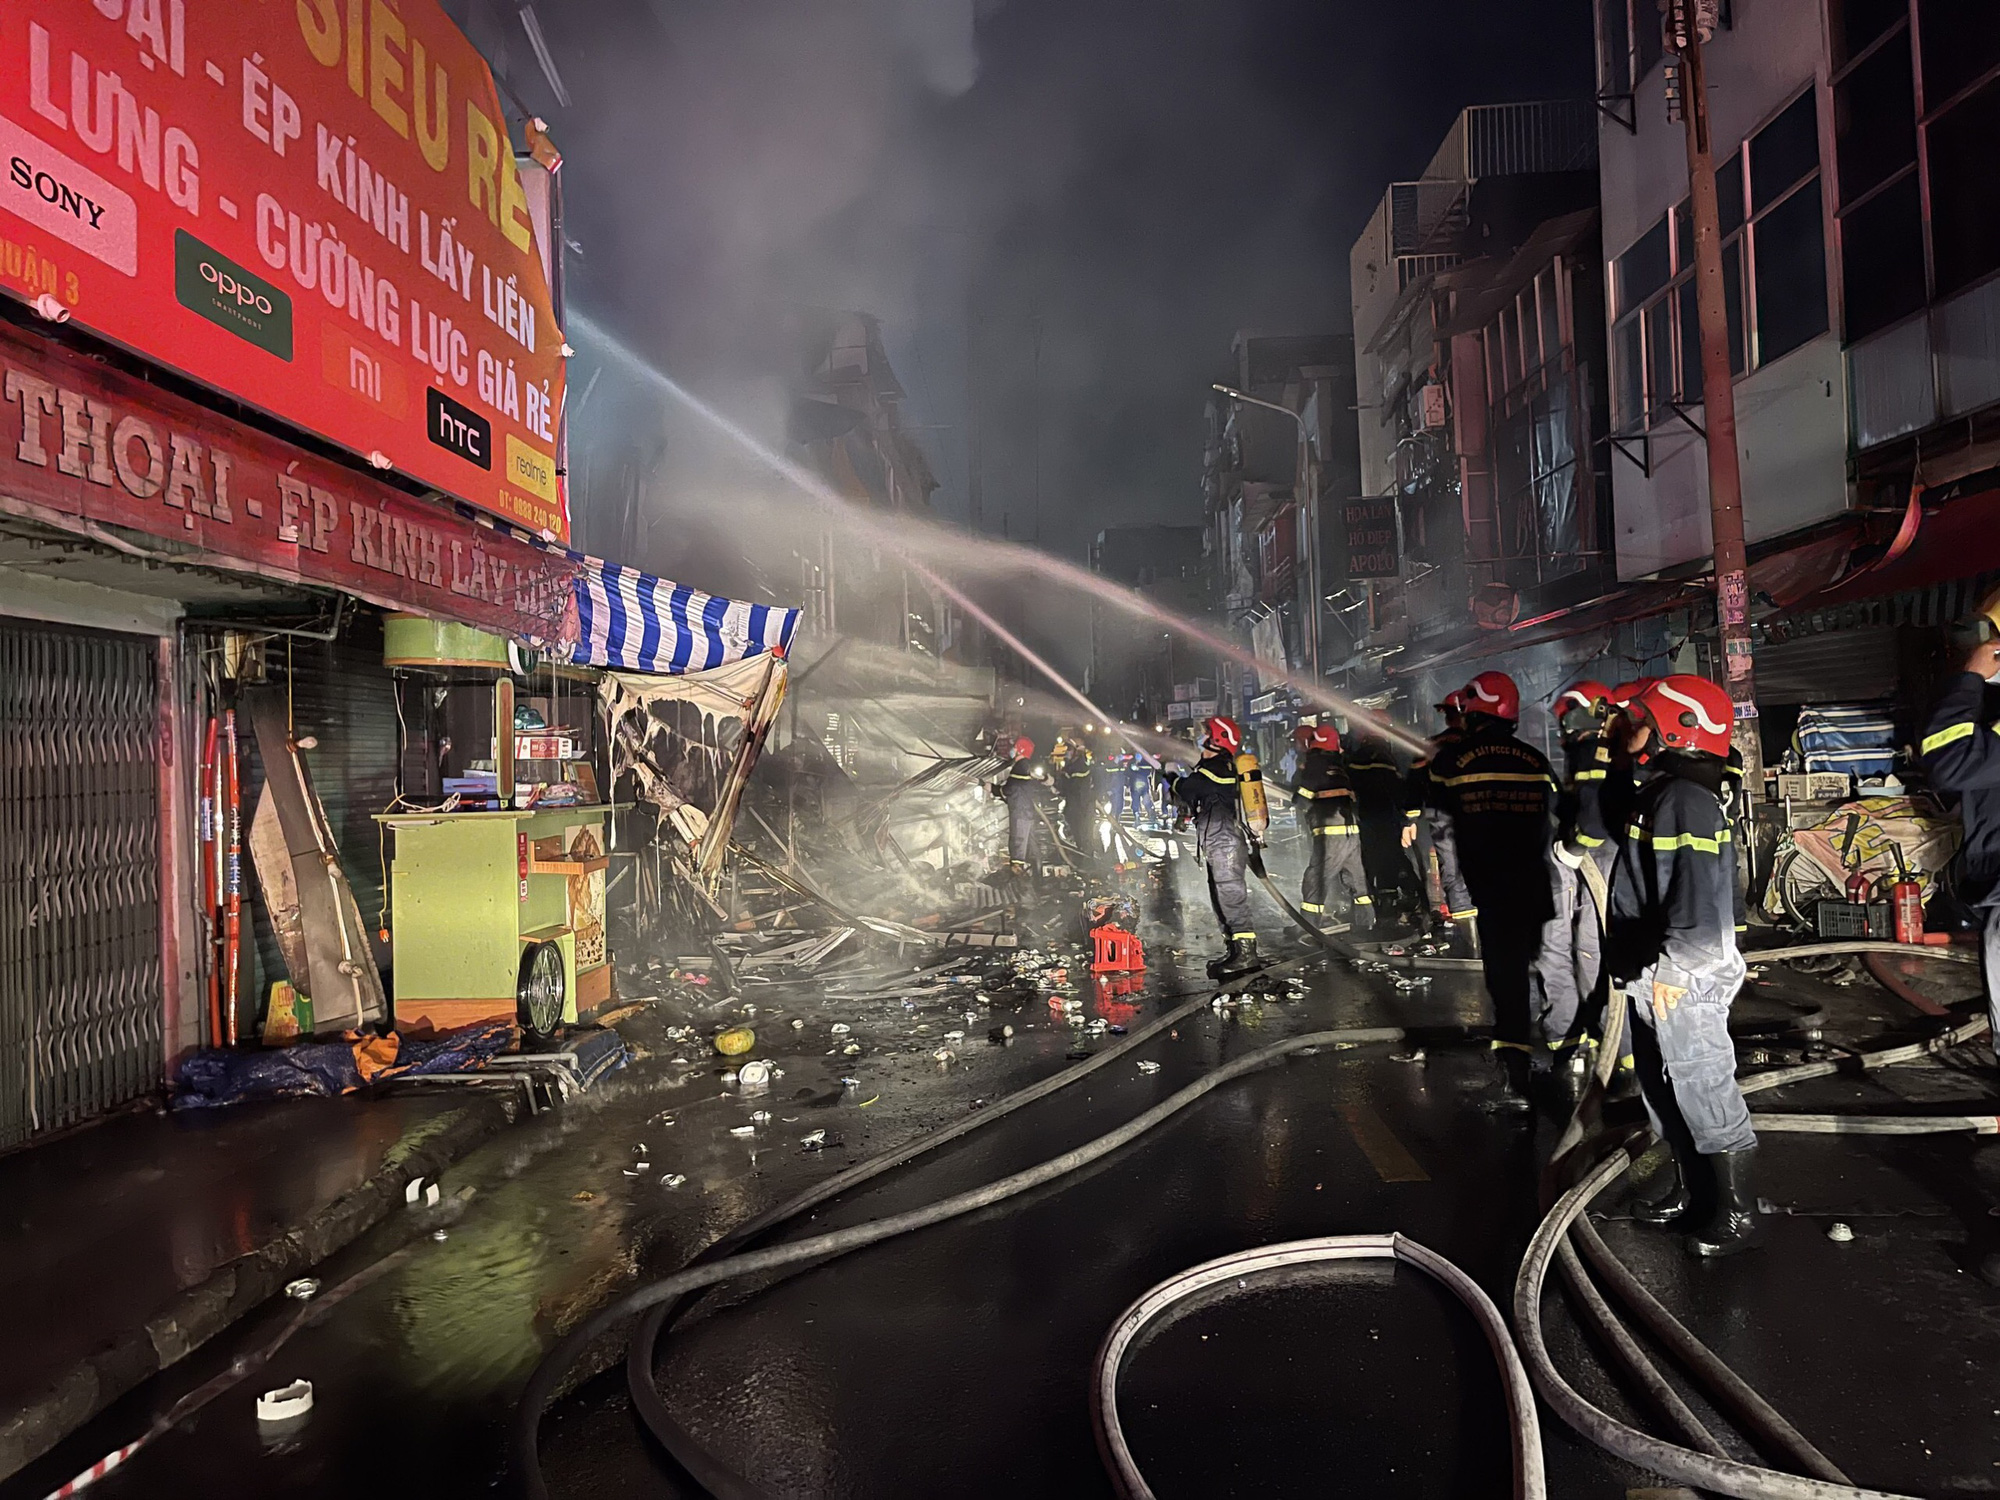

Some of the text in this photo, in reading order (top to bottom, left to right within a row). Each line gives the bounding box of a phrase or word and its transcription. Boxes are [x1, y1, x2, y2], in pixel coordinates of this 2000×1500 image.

[10, 156, 106, 231] SONY
[91, 0, 185, 78] ẠI
[243, 51, 300, 157] ÉP
[316, 121, 409, 254] KÍNH
[420, 209, 474, 302] LẤY
[482, 263, 535, 354] LIỀN
[29, 20, 200, 218] LƯNG
[256, 192, 400, 346] CƯỜNG
[410, 298, 468, 387] LỰC
[477, 348, 519, 423] GIÁ
[526, 378, 553, 444] RẺ
[0, 236, 79, 306] UẬN 3
[5, 367, 233, 530] THOẠI
[277, 460, 339, 554] ÉP
[350, 497, 443, 589] KÍNH
[450, 527, 508, 607] LẤY
[516, 455, 547, 486] realme
[533, 505, 548, 528] 240
[548, 513, 562, 534] 120
[1490, 745, 1511, 755] PCCC
